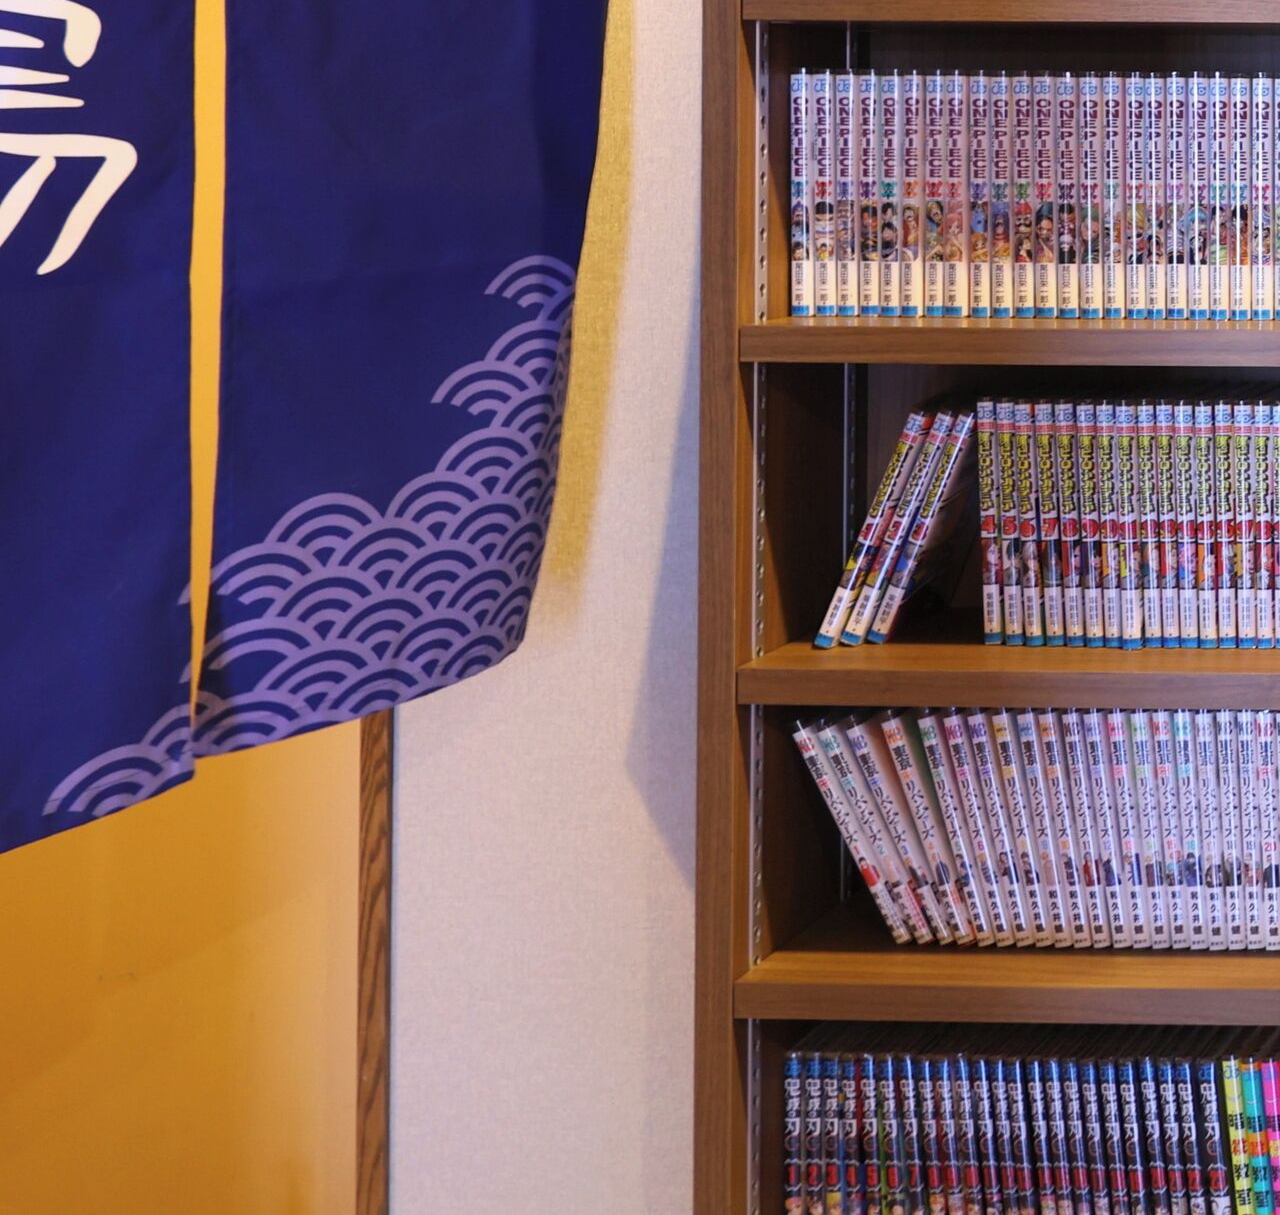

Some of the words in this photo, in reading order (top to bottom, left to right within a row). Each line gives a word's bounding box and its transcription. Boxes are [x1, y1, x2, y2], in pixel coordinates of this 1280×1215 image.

[883, 98, 895, 128] ONE
[883, 129, 895, 178] PIECE
[982, 515, 996, 533] 4
[1003, 516, 1017, 533] 5
[1020, 520, 1035, 535] 6
